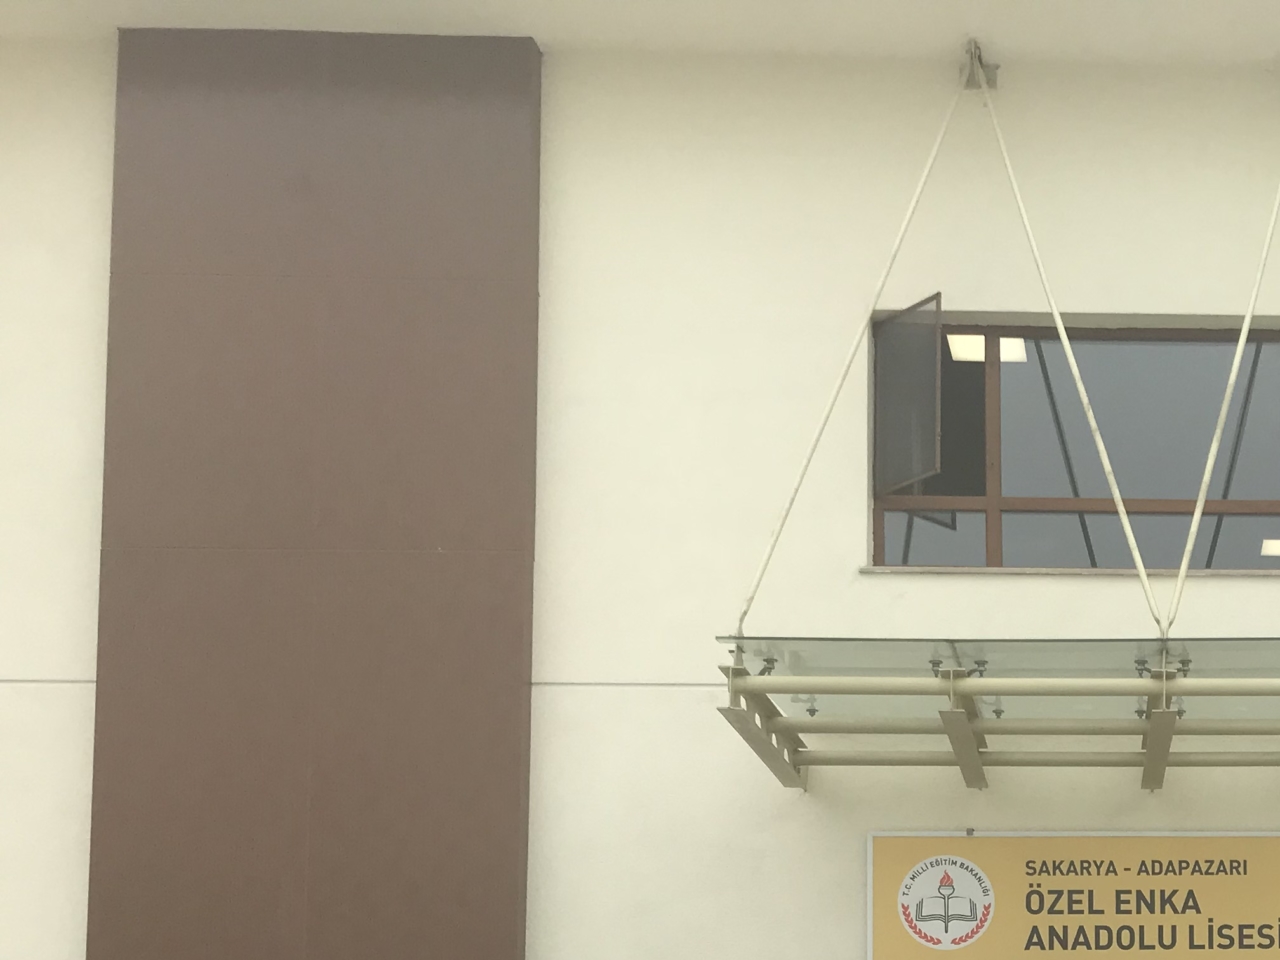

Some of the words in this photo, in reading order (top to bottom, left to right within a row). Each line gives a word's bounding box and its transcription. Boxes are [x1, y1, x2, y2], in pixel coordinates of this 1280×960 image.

[902, 883, 913, 897] T.C.
[909, 862, 930, 883] MİLLİ
[929, 857, 958, 869] EĞİTİM
[958, 862, 991, 897] BAKANLIĞI
[1025, 860, 1118, 877] SAKARYA
[1137, 859, 1248, 876] ADAPAZARI
[1025, 883, 1105, 915] ÖZEL
[1115, 889, 1202, 915] ENKA
[1024, 925, 1178, 951] ANADOLU
